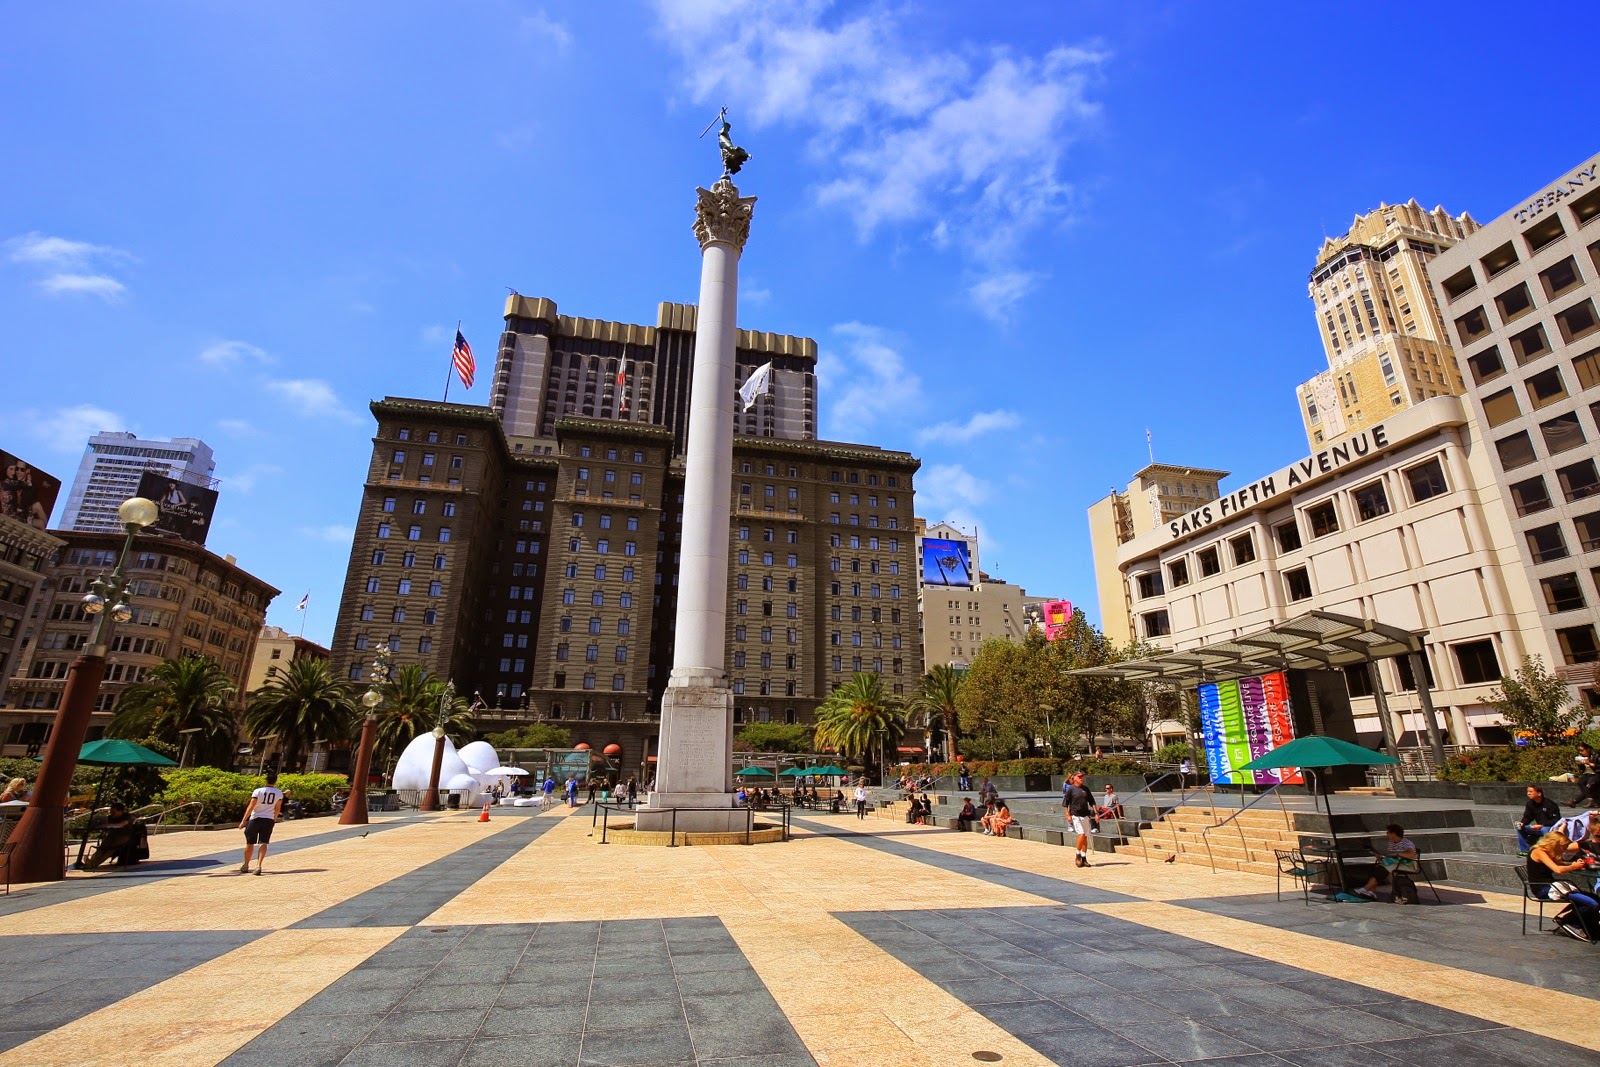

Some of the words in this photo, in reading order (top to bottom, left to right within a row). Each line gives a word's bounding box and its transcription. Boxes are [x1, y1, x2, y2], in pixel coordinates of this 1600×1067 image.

[1513, 163, 1597, 225] TIFFANY
[1170, 506, 1213, 538] SAKS
[1219, 477, 1276, 518] FIFTH
[1287, 424, 1389, 486] AVENUE
[1242, 683, 1252, 703] LIVE
[1202, 709, 1215, 746] SQUARE
[1246, 705, 1258, 743] SQUARE
[1268, 701, 1284, 742] SQUARE
[1207, 747, 1219, 779] UNION
[1252, 746, 1264, 779] UNON
[261, 792, 276, 805] 10
